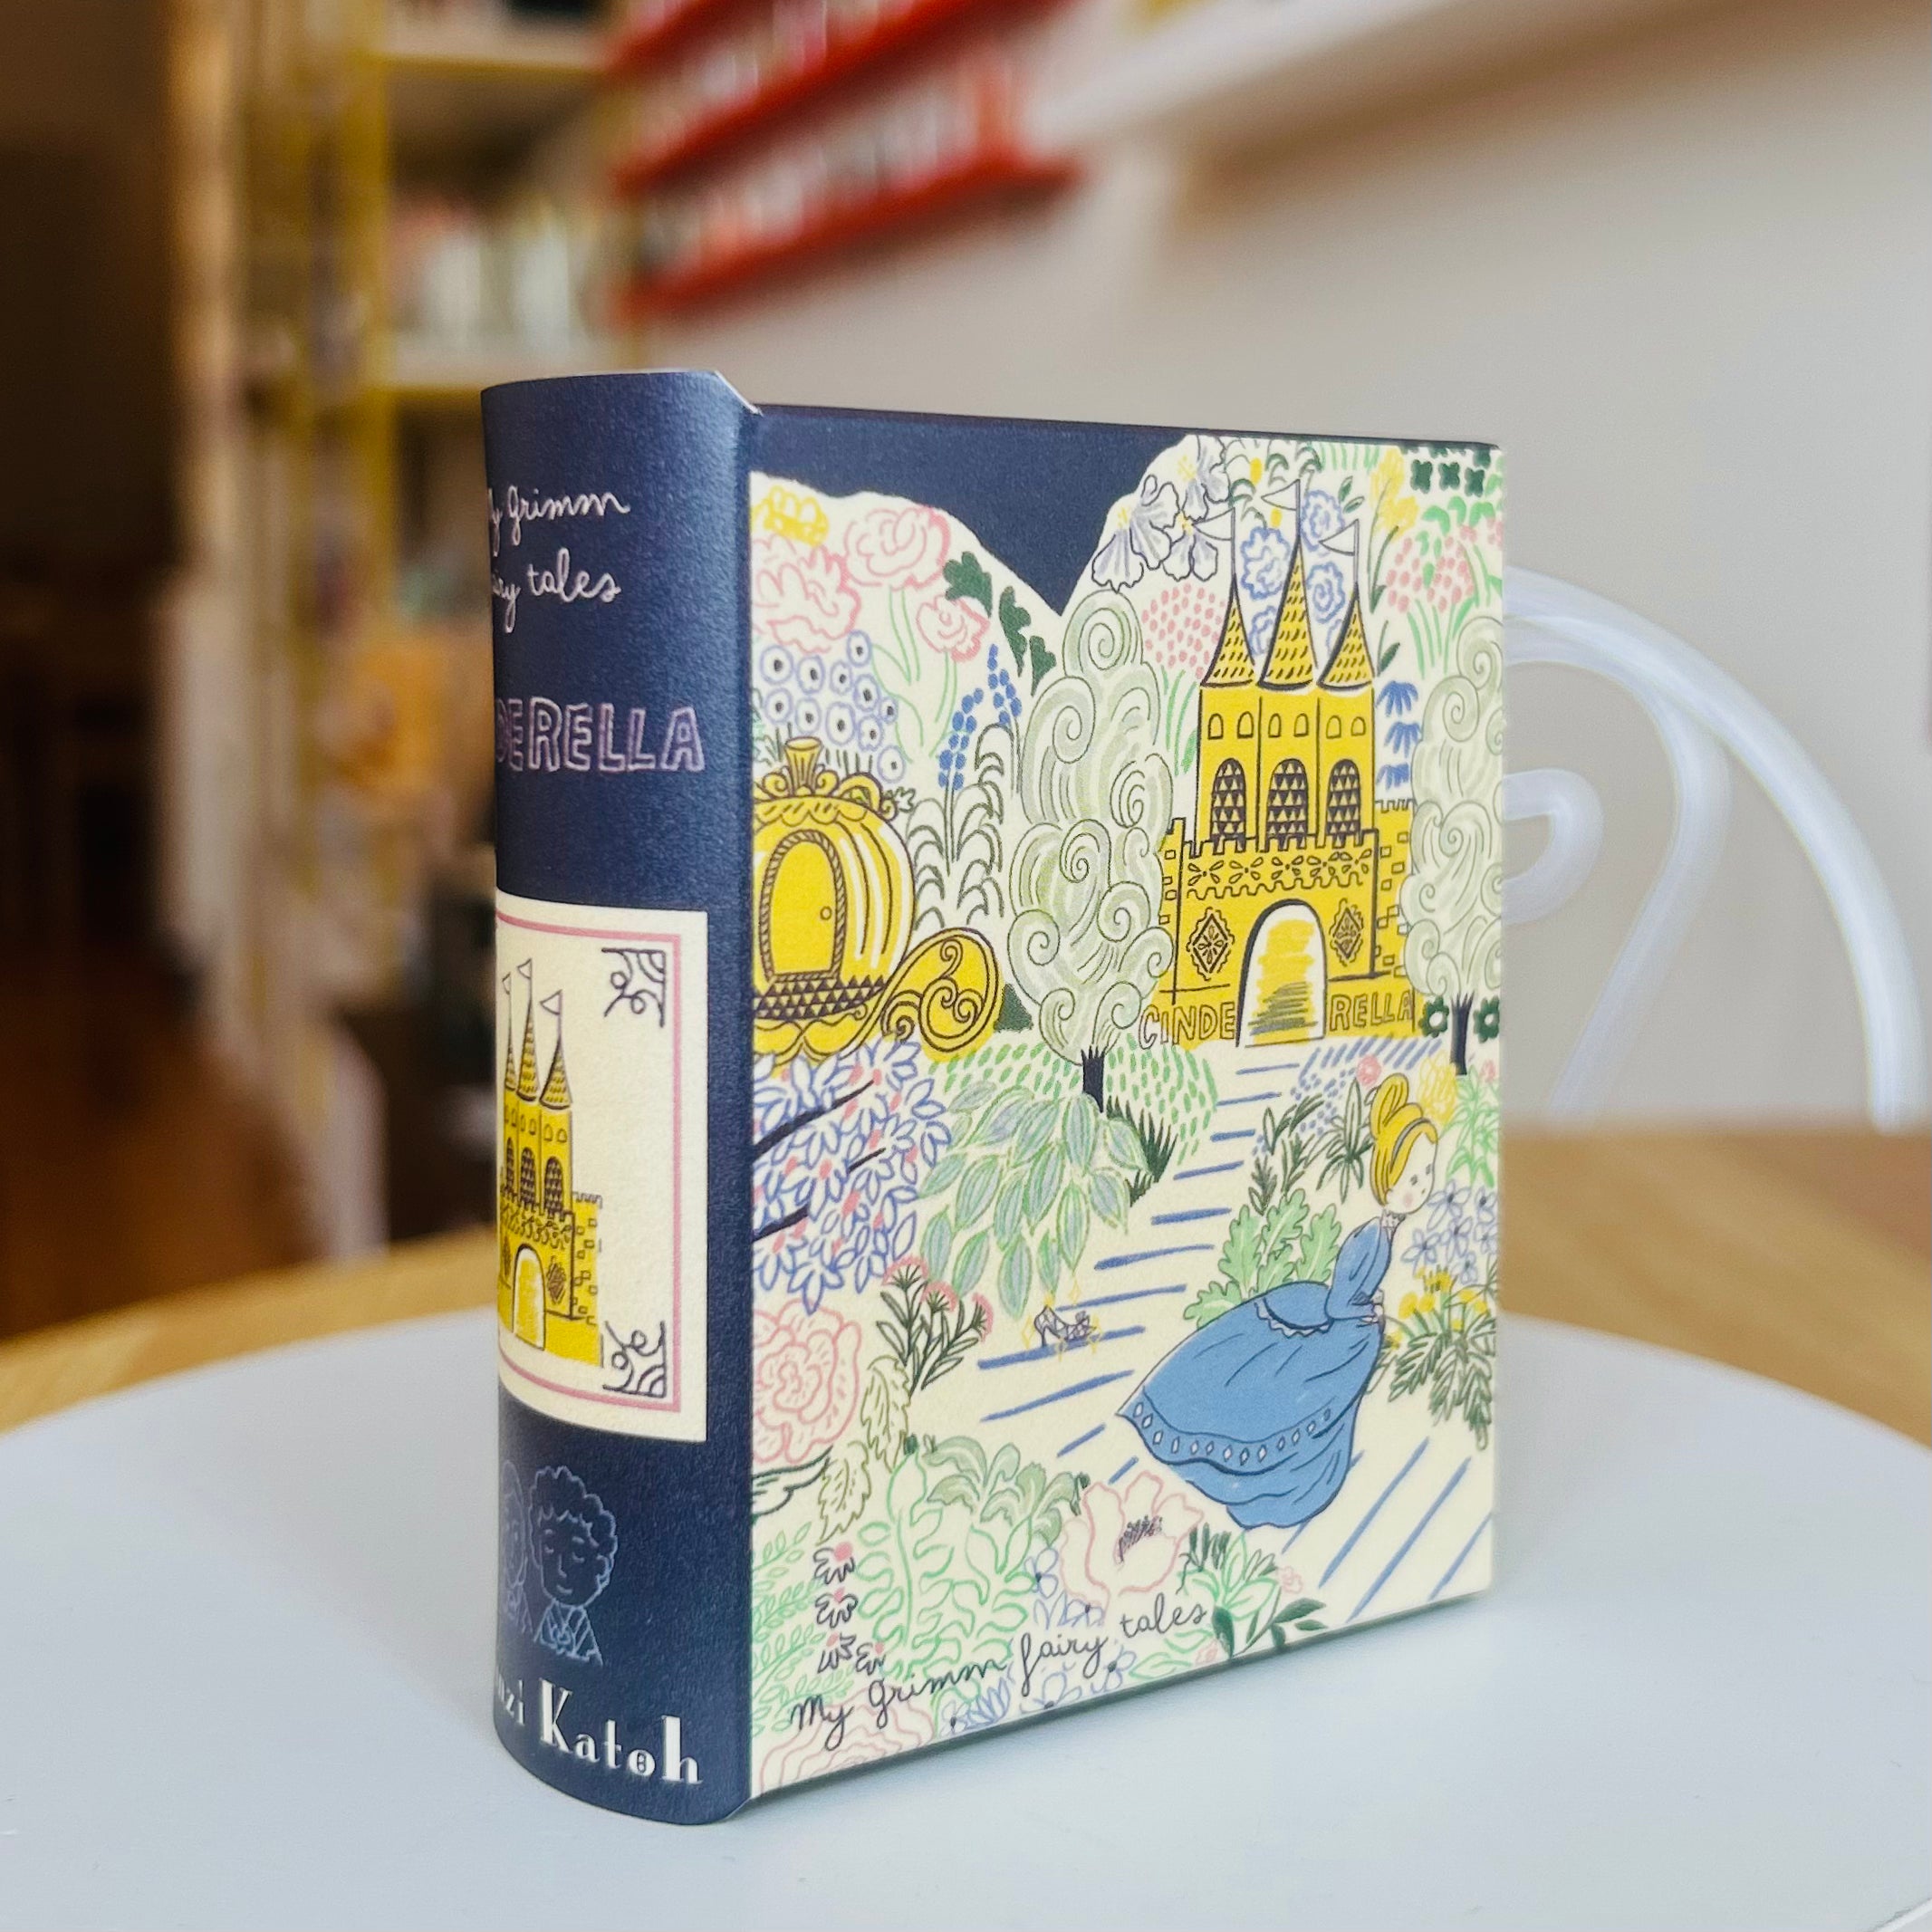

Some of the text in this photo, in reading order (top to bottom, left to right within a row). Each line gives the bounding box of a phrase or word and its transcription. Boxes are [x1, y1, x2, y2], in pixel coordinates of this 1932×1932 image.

[507, 485, 631, 546] grimm
[526, 547, 622, 603] tales
[495, 696, 706, 772] DERELLA
[1139, 989, 1415, 1050] CINDE RELLA
[790, 1591, 1208, 1752] My grimm fairy tales
[539, 1677, 704, 1784] Katoh
